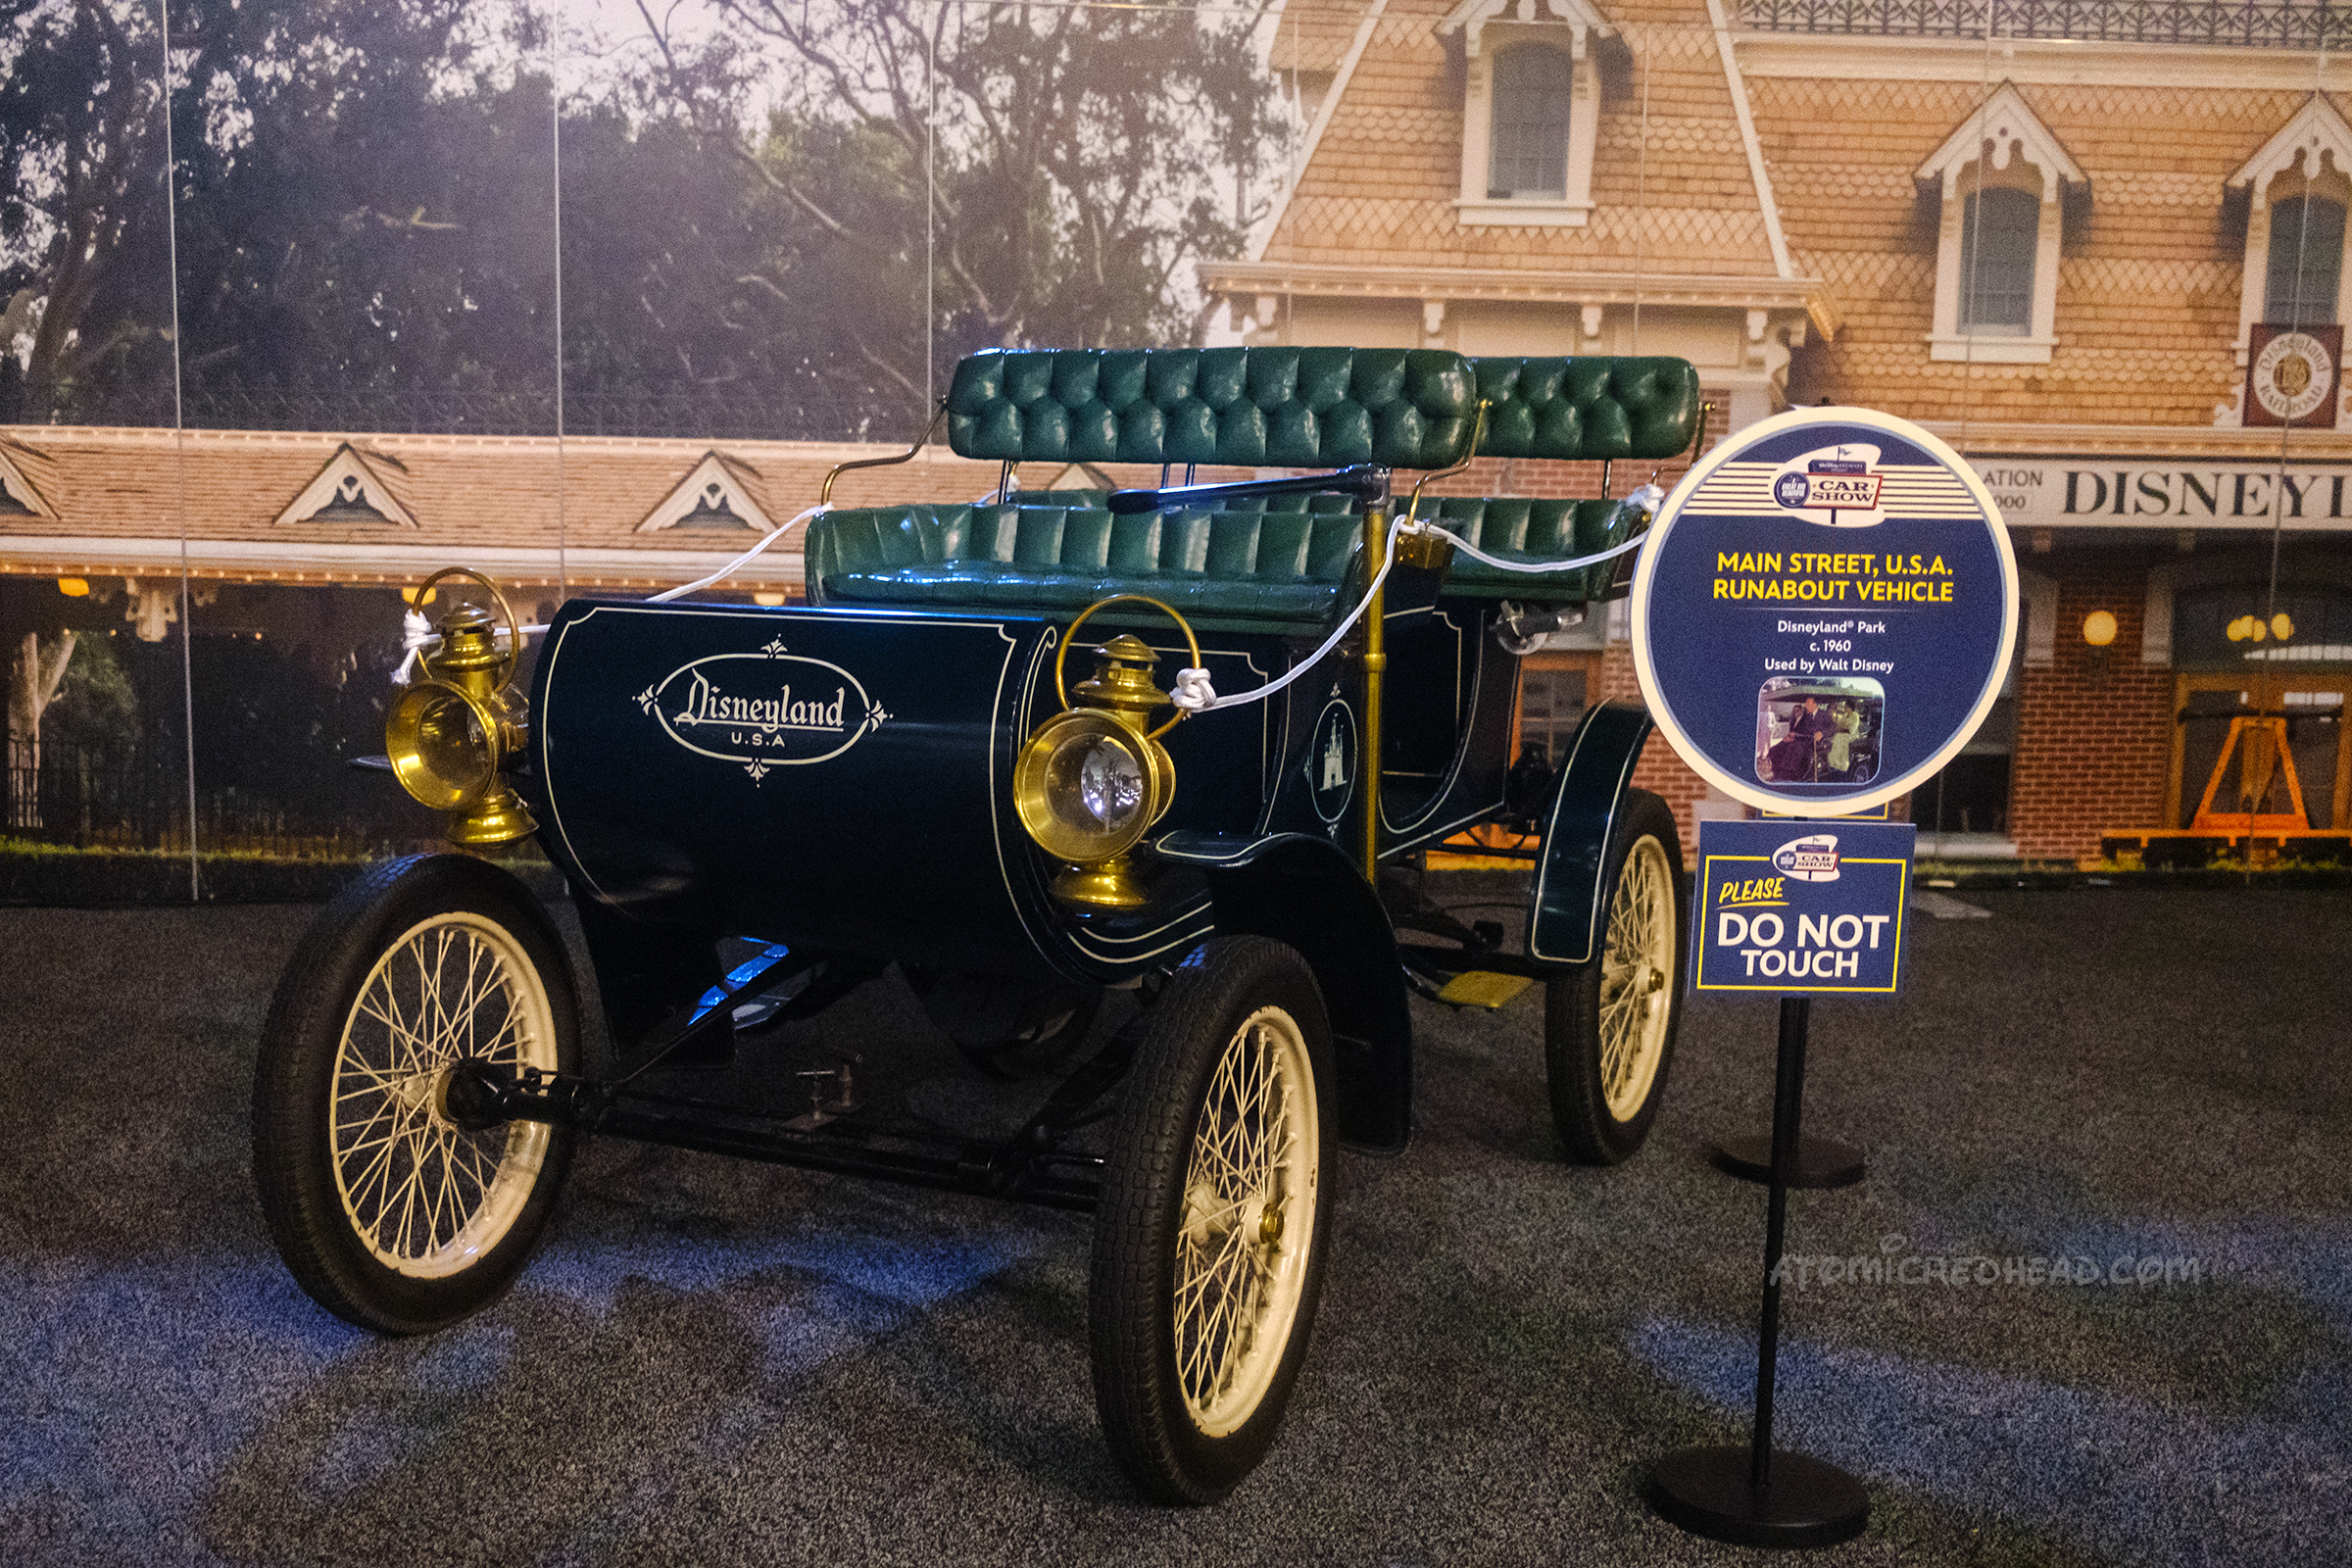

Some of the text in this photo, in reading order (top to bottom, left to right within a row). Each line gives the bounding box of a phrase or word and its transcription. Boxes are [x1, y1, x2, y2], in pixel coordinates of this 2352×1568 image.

[1819, 480, 1870, 491] CAR
[1983, 469, 2043, 487] ATION
[1812, 491, 1875, 502] SHOW
[1717, 552, 1953, 578] MAIN STREET, U.S.A.
[1713, 579, 1954, 602] RUNABOUT VEHICLE
[1857, 621, 1886, 633] Park
[1809, 640, 1851, 652] c. 1960
[1765, 659, 1894, 674] Used by Walt Disney
[673, 667, 845, 734] Disneyland
[1718, 877, 1786, 904] PLEASE
[1718, 912, 1889, 949] DO NOT
[1740, 950, 1859, 978] TOUCH
